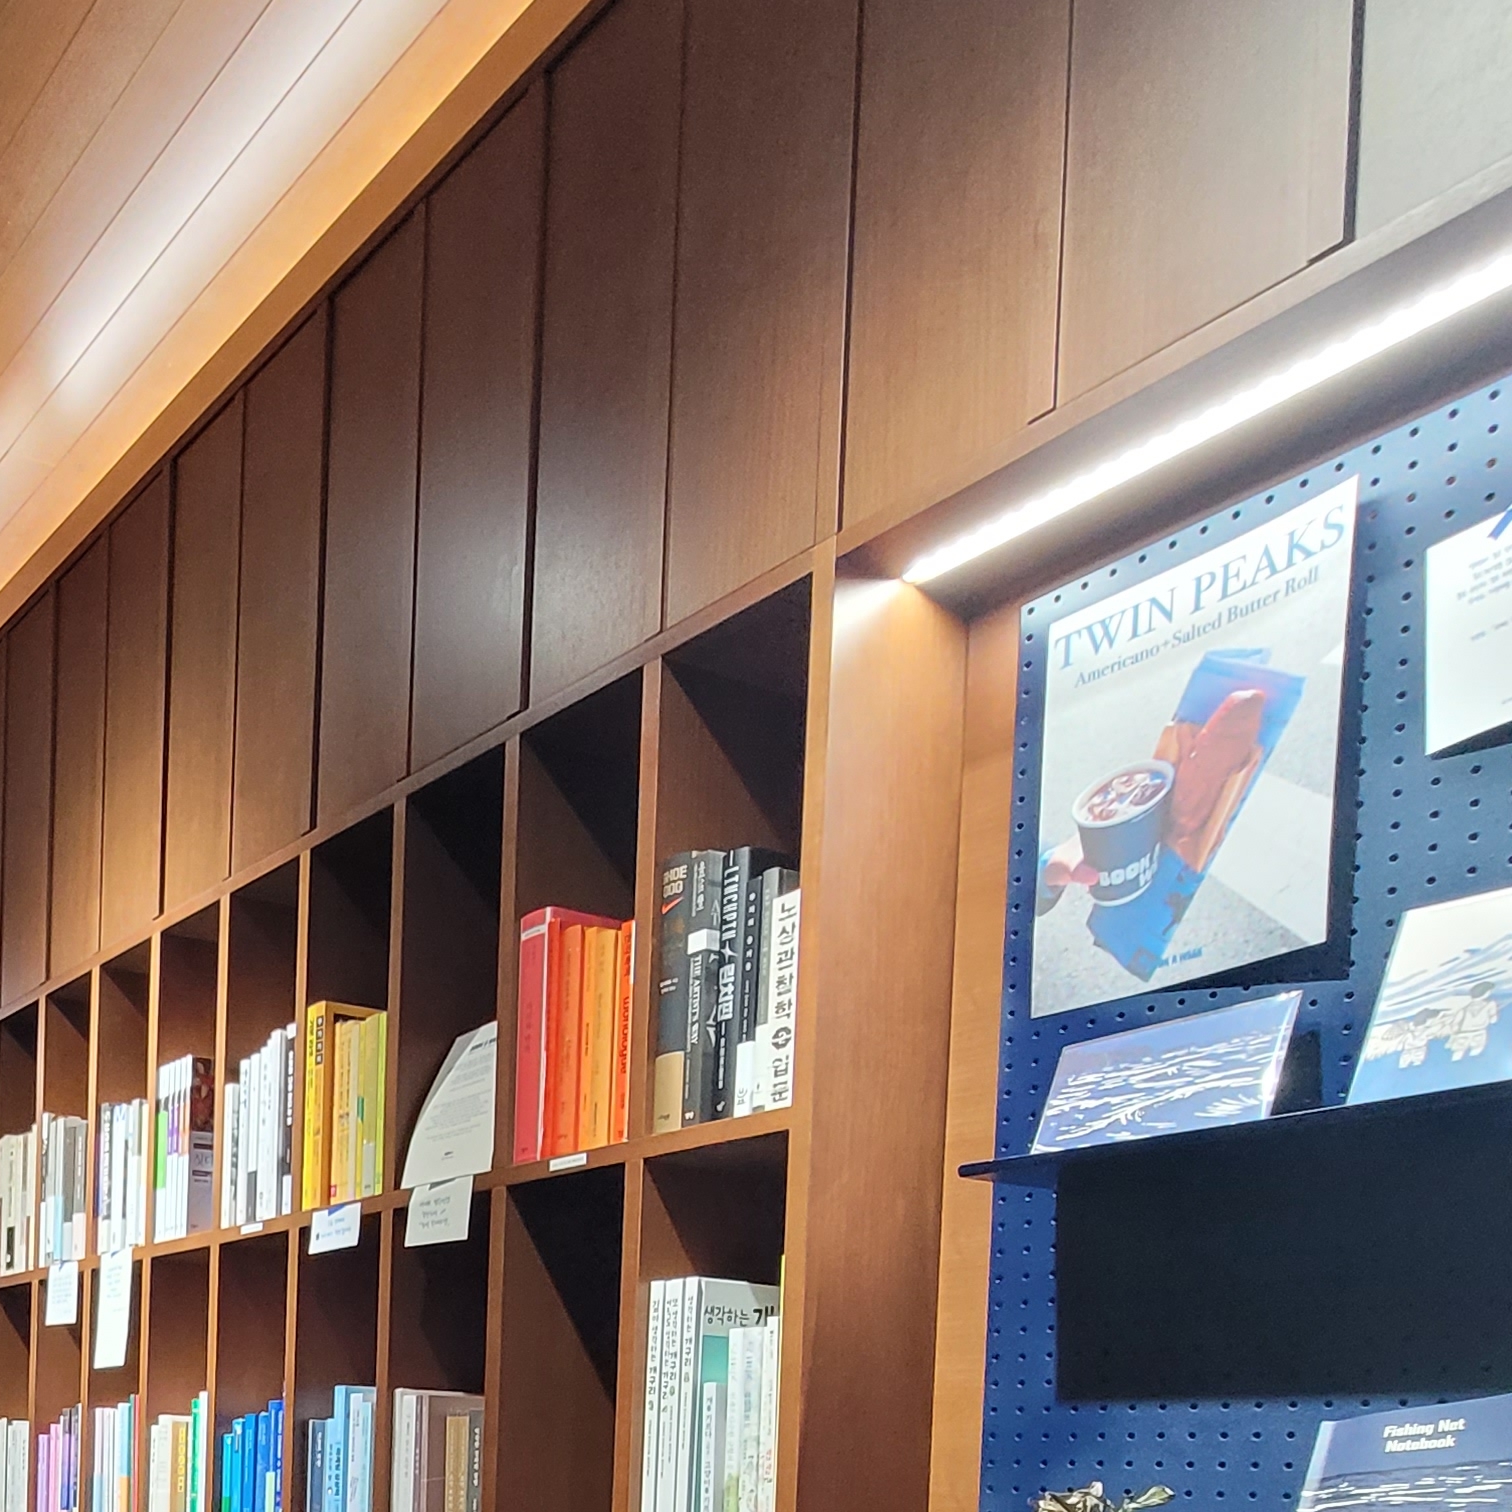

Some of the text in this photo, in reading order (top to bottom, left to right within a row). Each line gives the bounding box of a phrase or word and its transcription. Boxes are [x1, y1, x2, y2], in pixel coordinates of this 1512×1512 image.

[1054, 504, 1346, 671] TWIN PEAKS
[1226, 590, 1281, 625] Butter
[1284, 564, 1320, 598] Roll
[721, 865, 740, 941] LINCHPIN
[717, 963, 736, 1022] 린치핀
[704, 1305, 751, 1327] 생각하는
[1383, 1418, 1467, 1438] Fishing Net
[1384, 1434, 1456, 1453] Notebook
